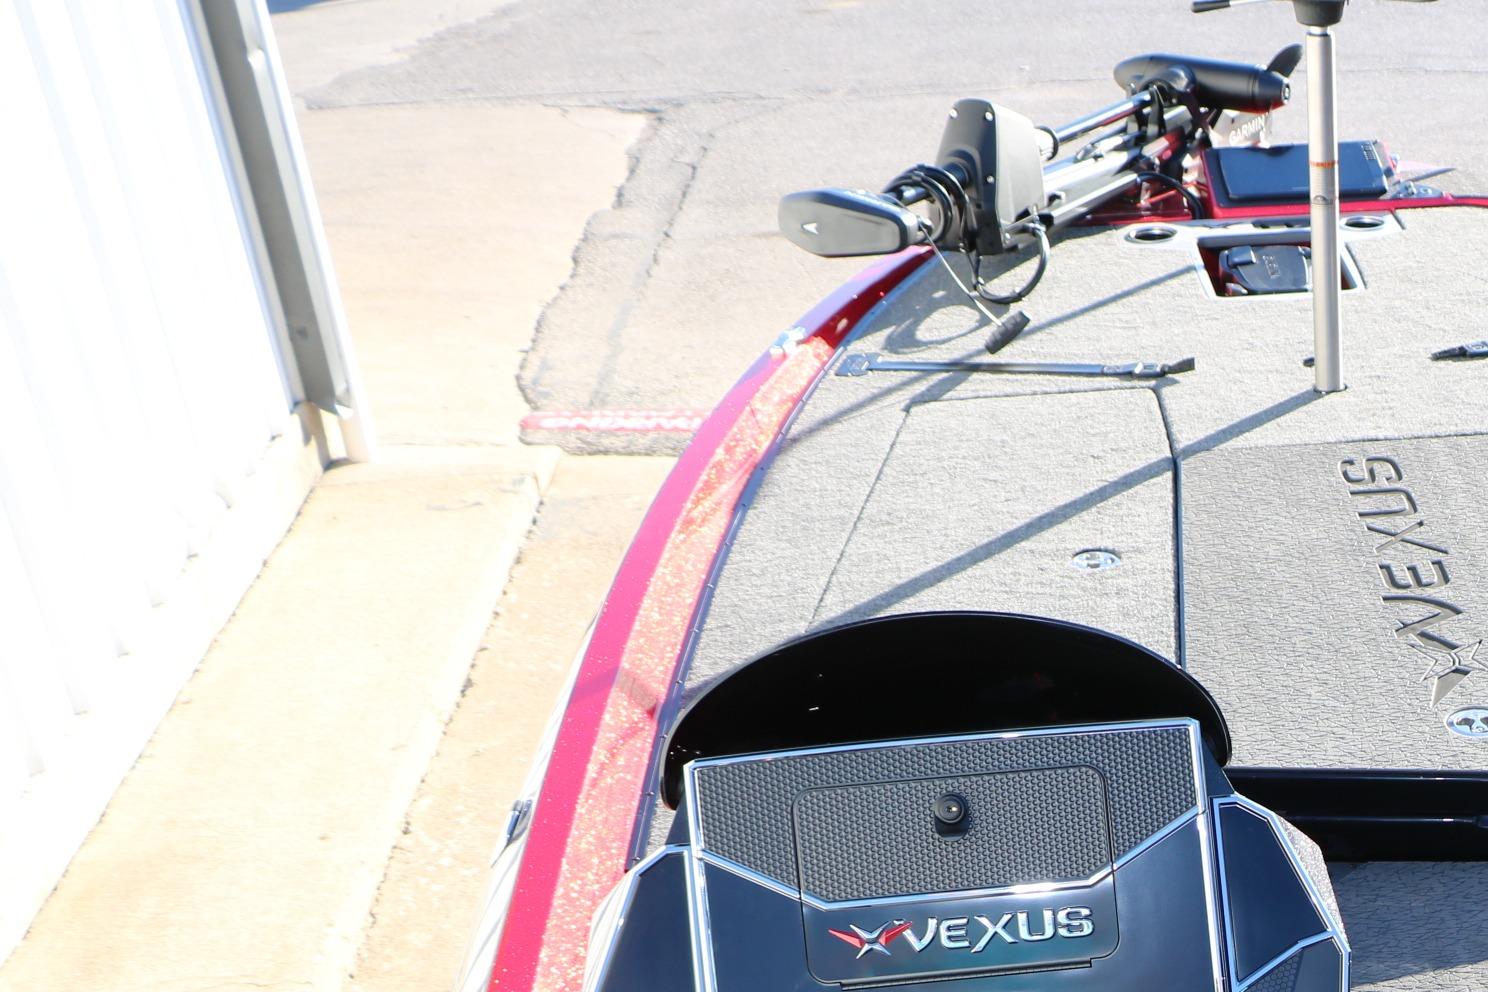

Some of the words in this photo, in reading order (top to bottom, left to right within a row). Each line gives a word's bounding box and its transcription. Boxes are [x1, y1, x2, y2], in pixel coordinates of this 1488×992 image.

[1229, 114, 1266, 141] GARMIN
[1337, 455, 1466, 639] VEXUS
[892, 906, 1095, 953] VEXUS
